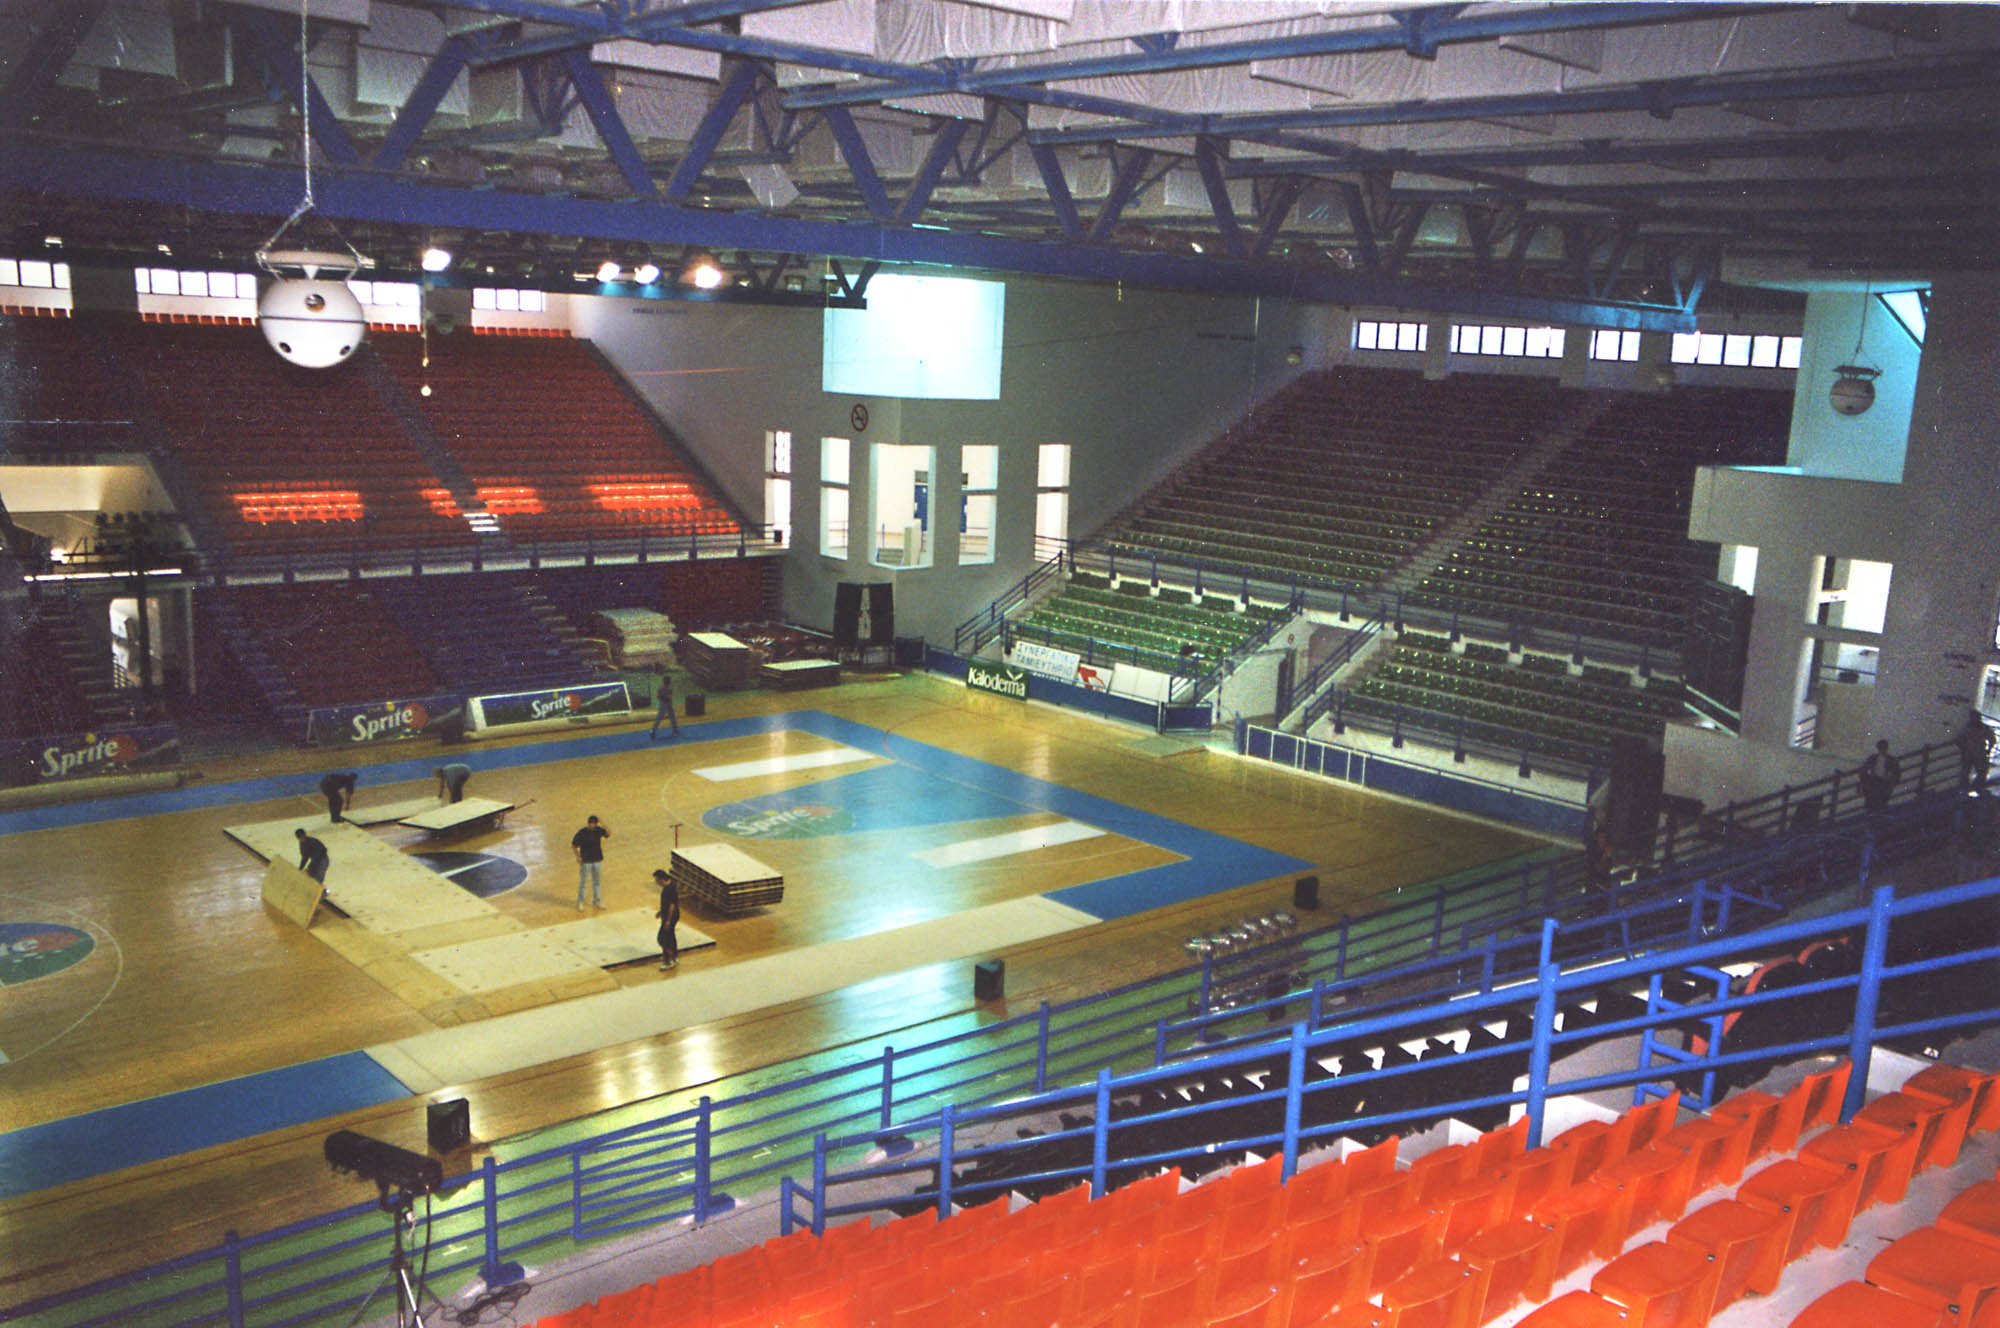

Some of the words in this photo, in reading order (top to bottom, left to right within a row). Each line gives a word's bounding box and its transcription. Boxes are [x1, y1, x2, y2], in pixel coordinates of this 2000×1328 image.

[968, 667, 1025, 697] Kaloderma
[531, 695, 571, 719] Sprite
[352, 706, 414, 741] Sprite
[41, 737, 119, 777] Sprite
